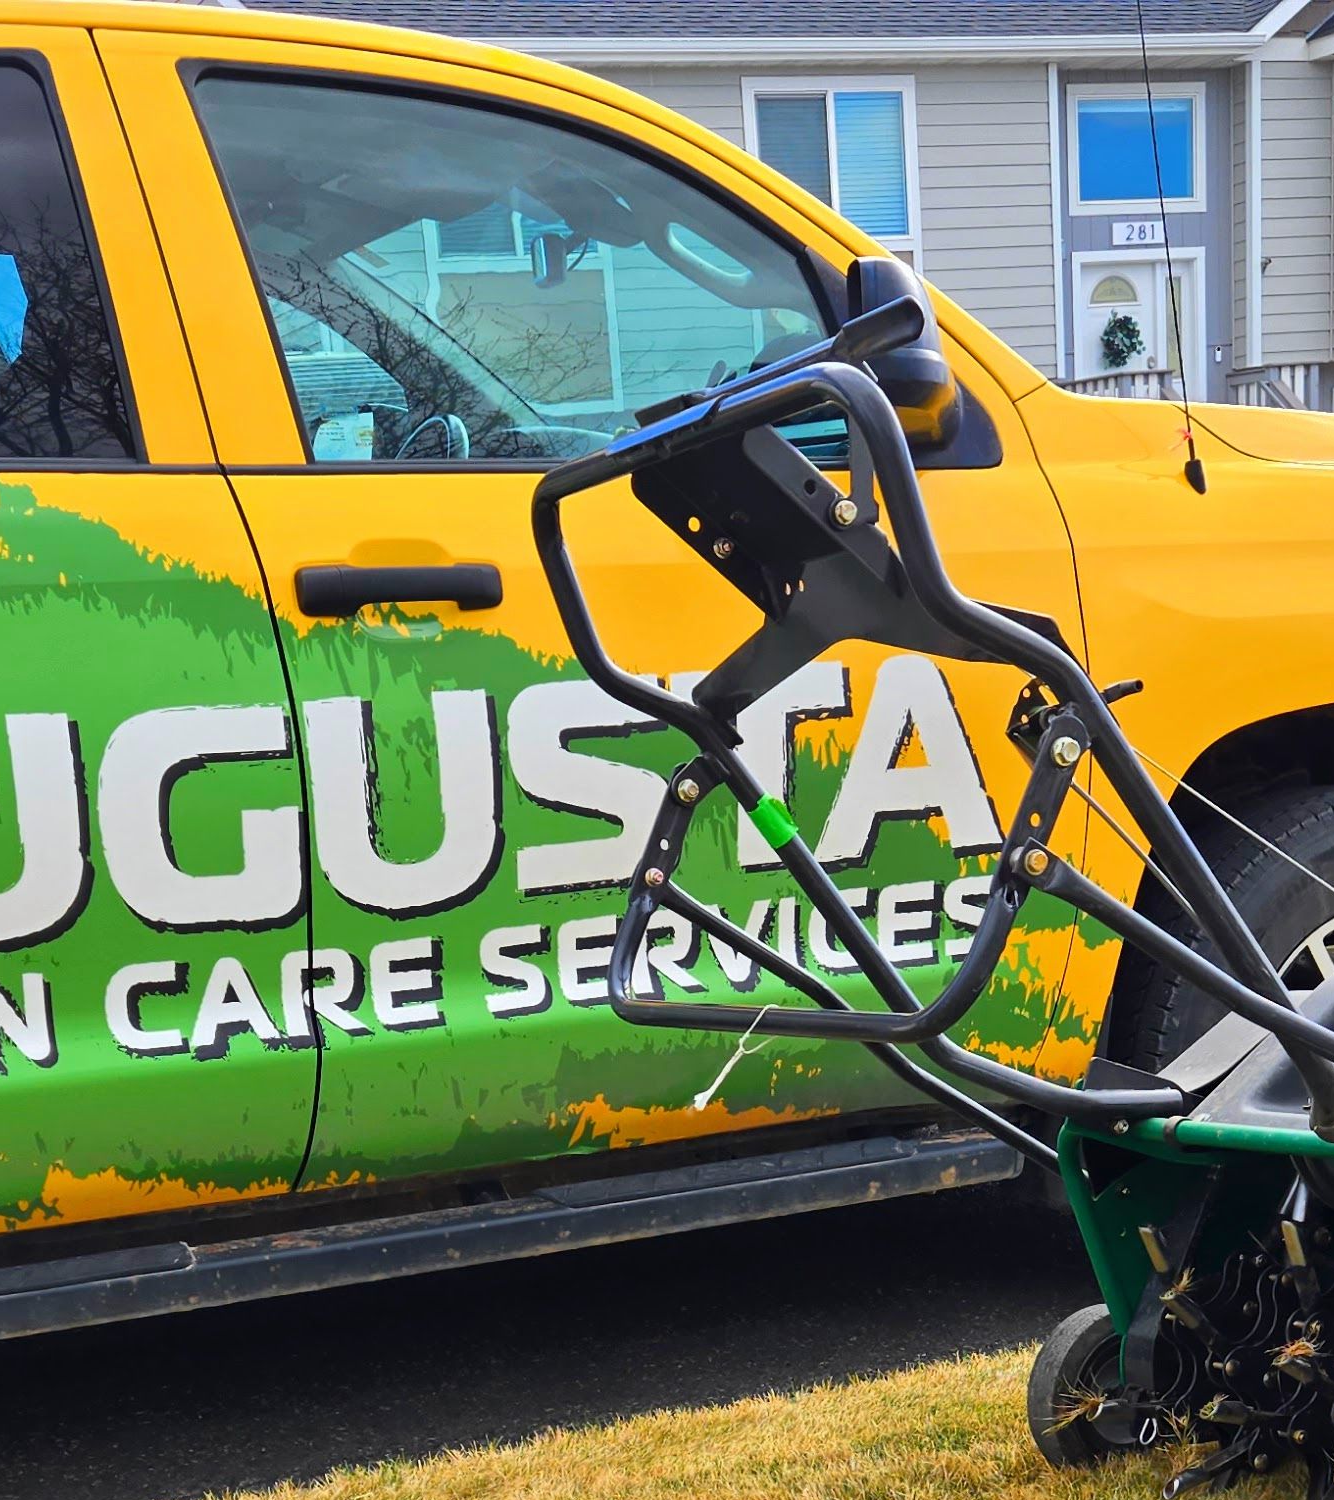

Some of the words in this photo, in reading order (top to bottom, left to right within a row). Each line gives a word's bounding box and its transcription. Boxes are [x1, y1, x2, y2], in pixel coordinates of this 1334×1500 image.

[1125, 223, 1156, 241] 281
[104, 936, 446, 1059] CARE
[478, 875, 995, 1020] SERVICES
